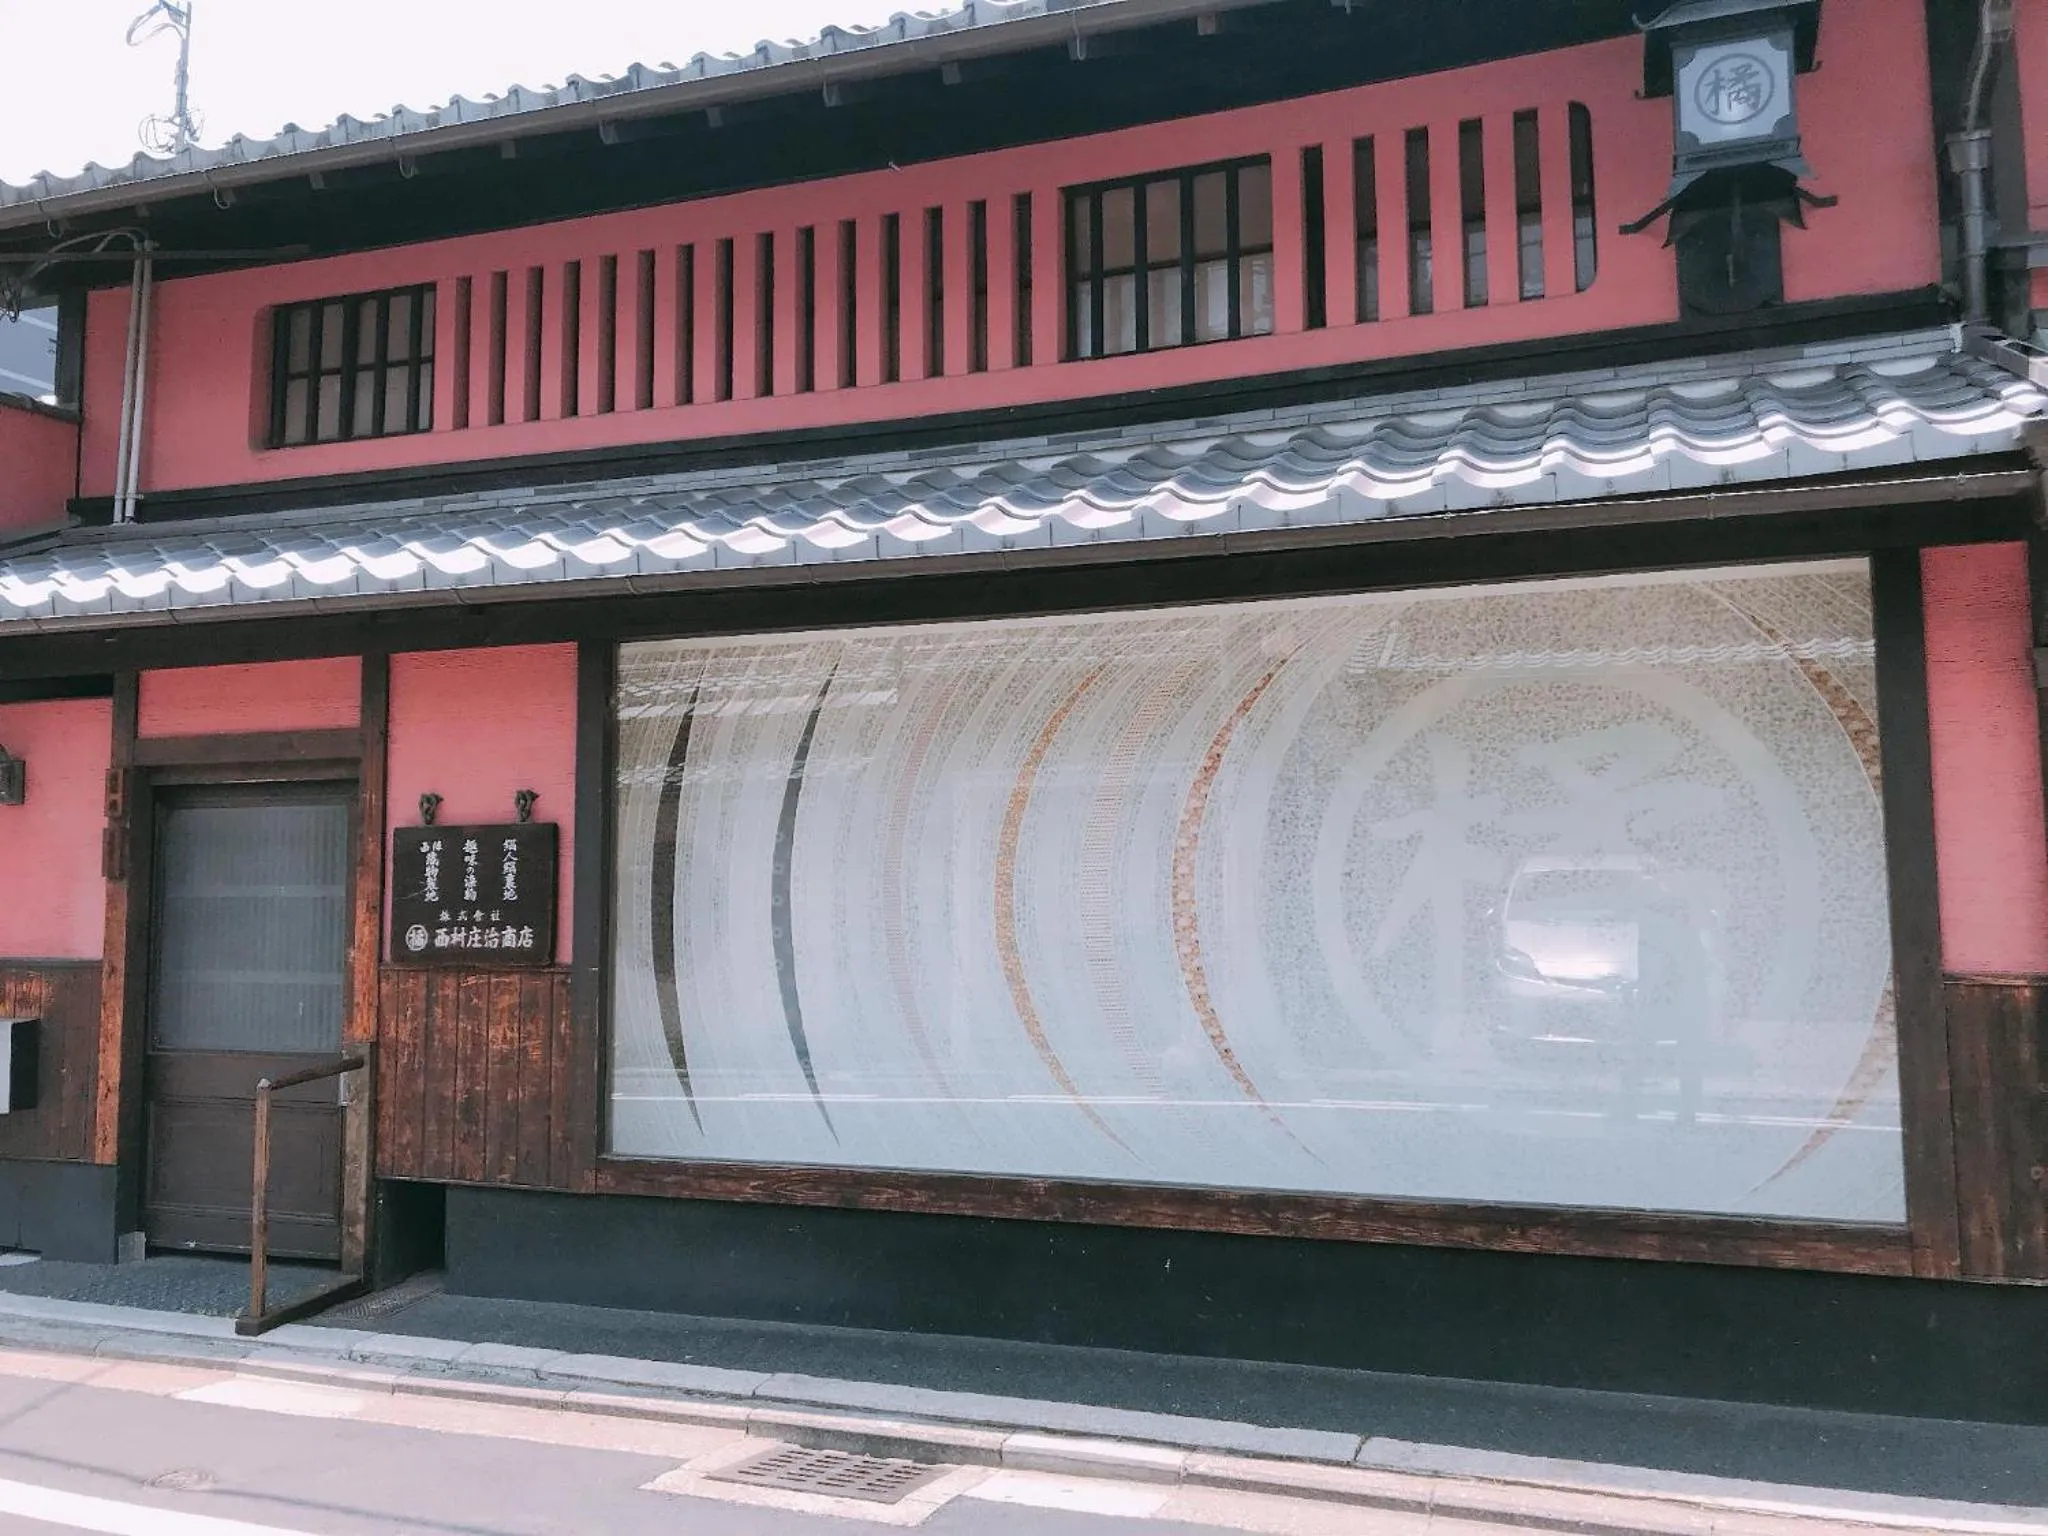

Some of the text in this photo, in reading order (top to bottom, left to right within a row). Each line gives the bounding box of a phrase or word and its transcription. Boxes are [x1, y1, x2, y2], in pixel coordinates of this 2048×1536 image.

[434, 926, 534, 948] 西村庄治商店
